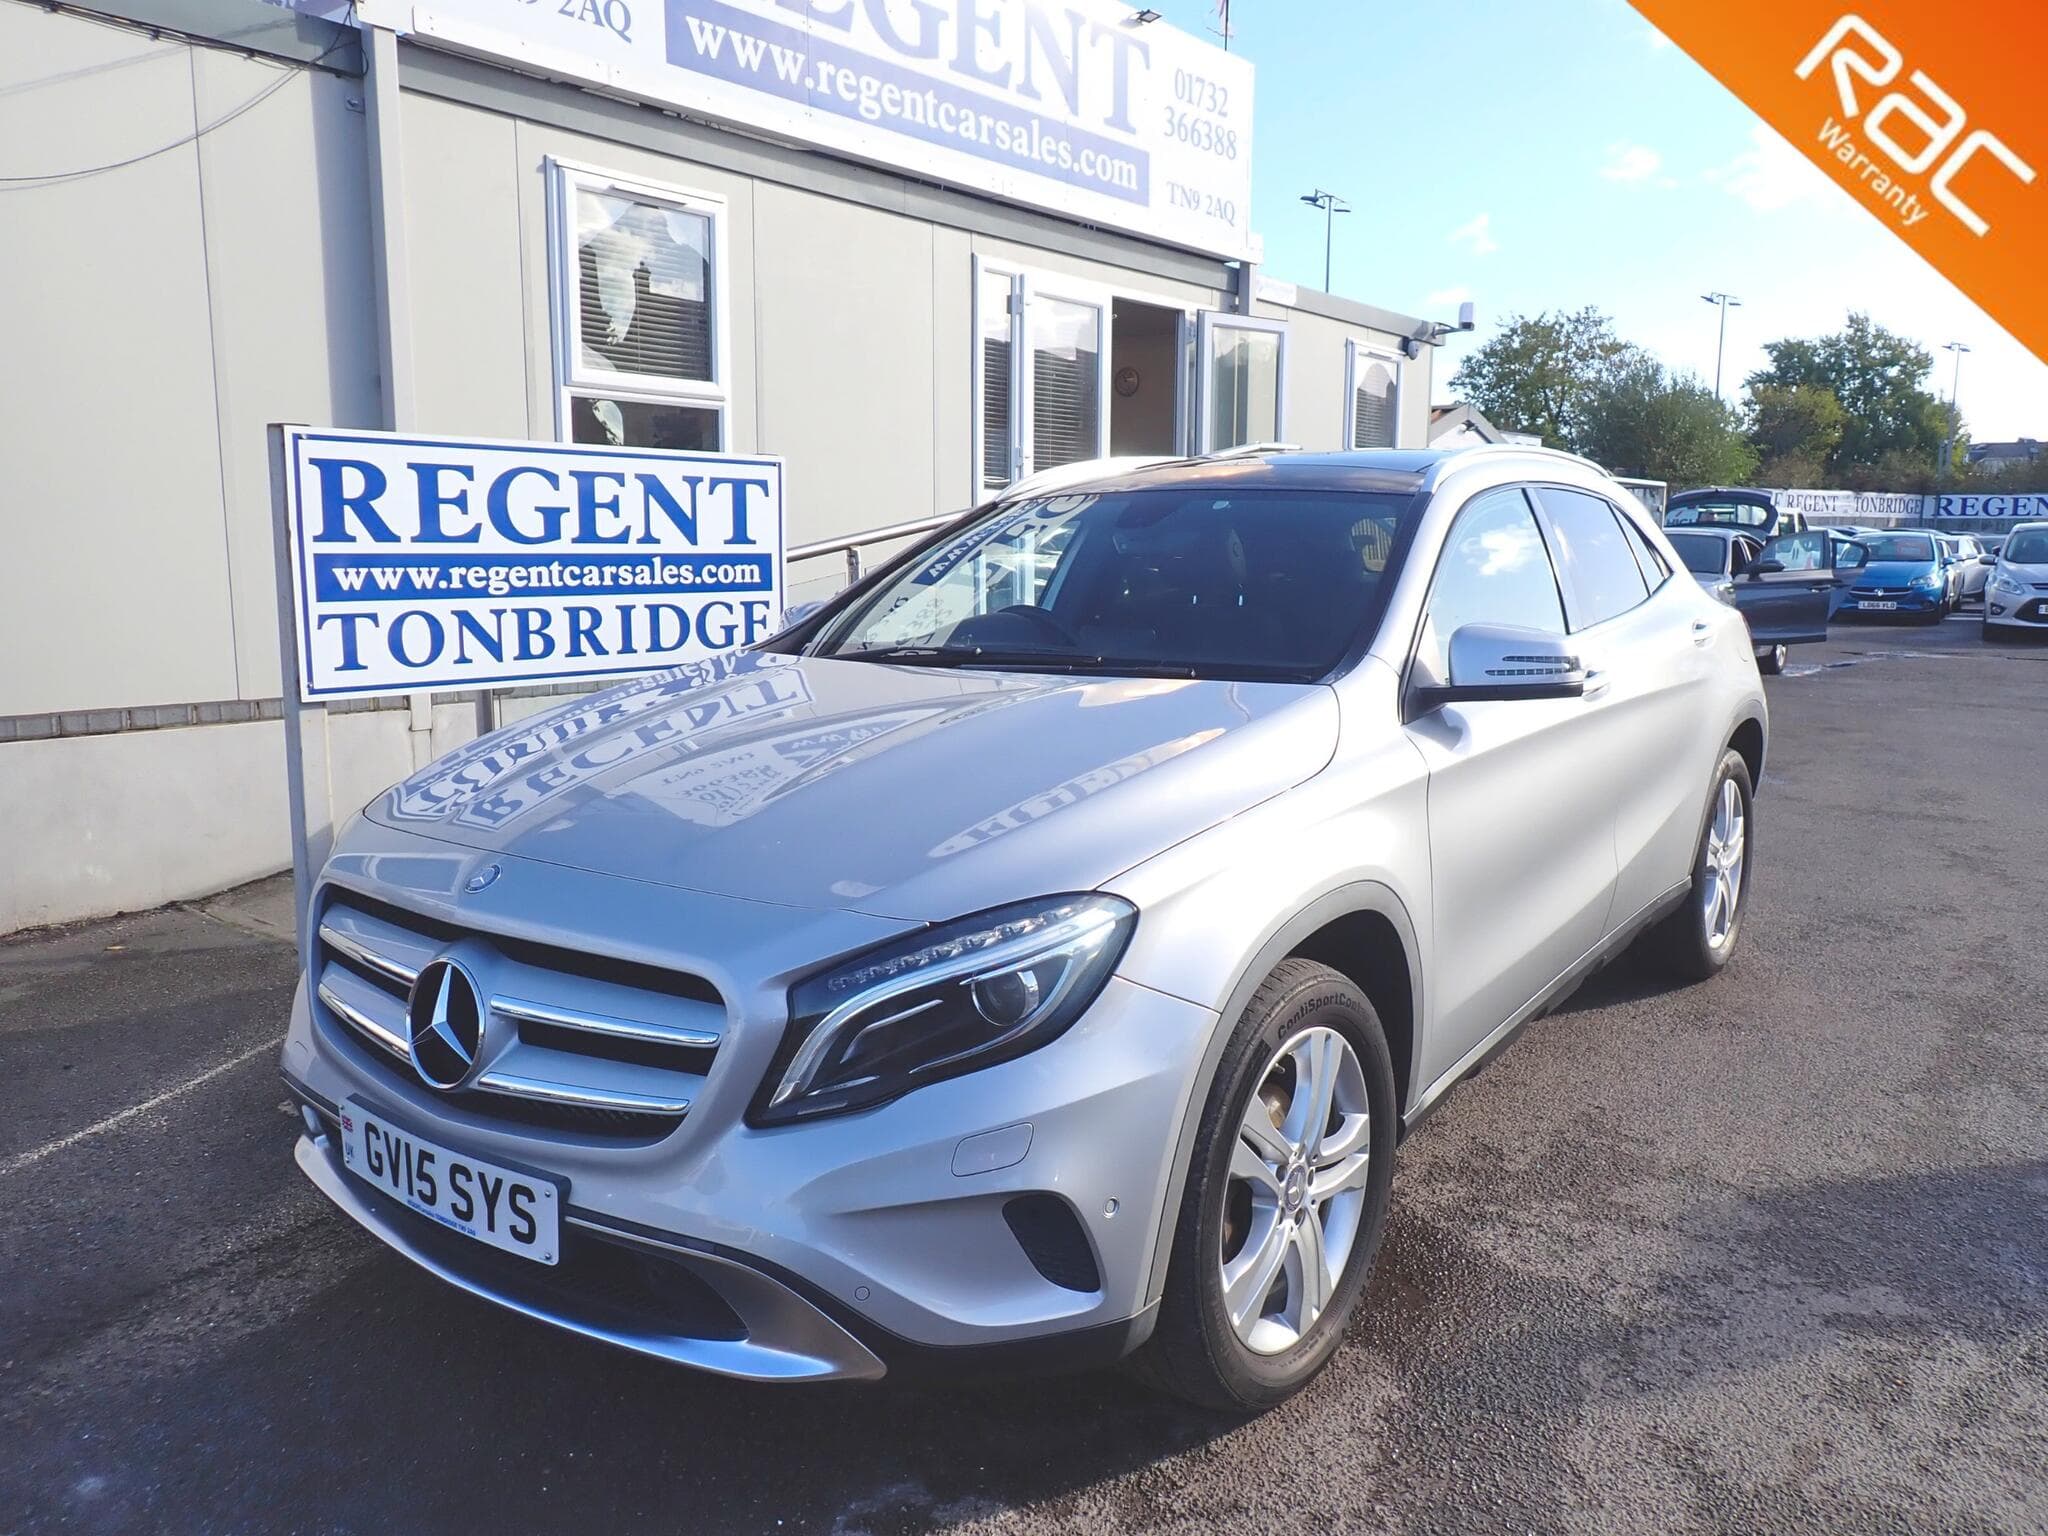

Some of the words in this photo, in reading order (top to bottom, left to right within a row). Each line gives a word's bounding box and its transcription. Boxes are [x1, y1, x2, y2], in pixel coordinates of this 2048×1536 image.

[760, 0, 1150, 136] GENT
[1174, 67, 1229, 118] 01732
[686, 15, 1138, 191] www.regentcarsales.com
[1163, 105, 1237, 161] 366388
[1166, 180, 1201, 211] TN9
[1205, 194, 1236, 228] 2AQ
[308, 457, 770, 546] REGENT
[1854, 496, 1921, 514] TONBRIDGE
[331, 556, 762, 595] www.regentcarsales.com
[317, 600, 774, 672] TONBRIDGE
[364, 1121, 437, 1207] GV15
[449, 1162, 537, 1245] SYS
